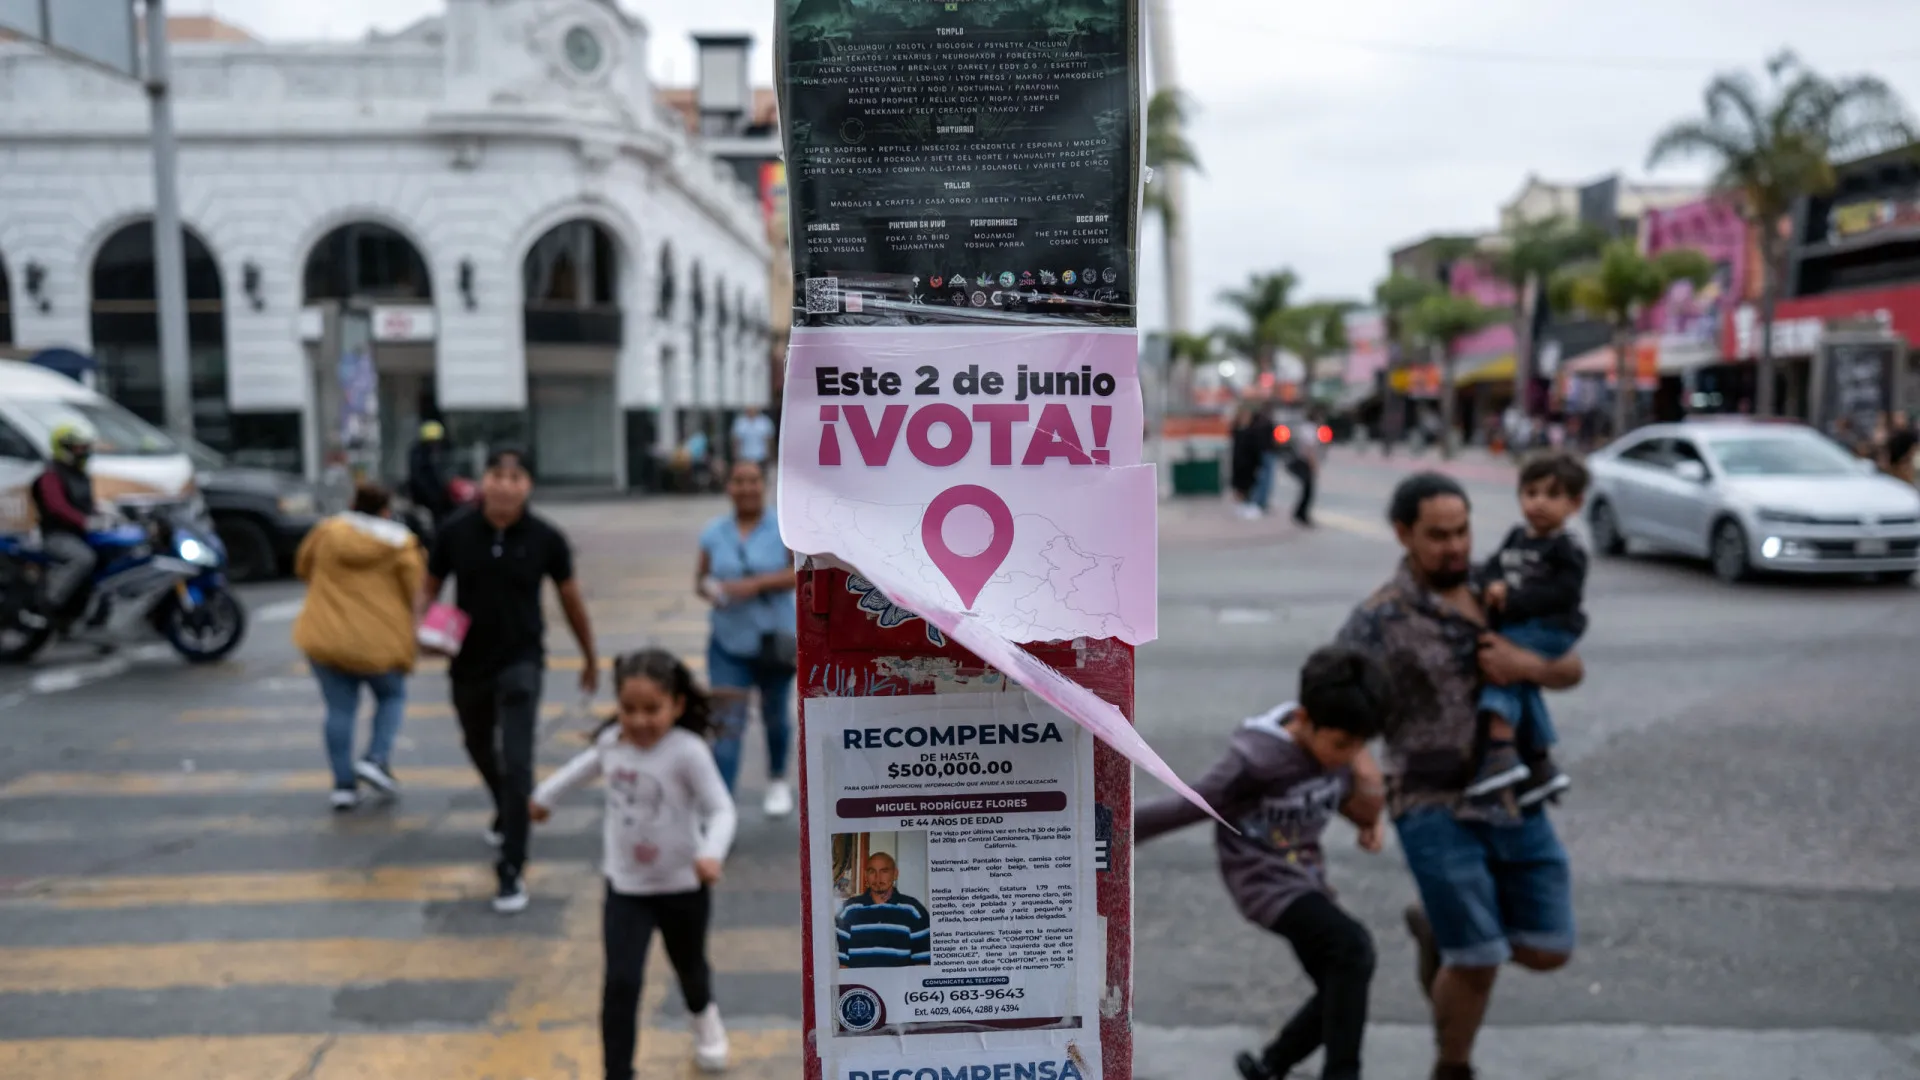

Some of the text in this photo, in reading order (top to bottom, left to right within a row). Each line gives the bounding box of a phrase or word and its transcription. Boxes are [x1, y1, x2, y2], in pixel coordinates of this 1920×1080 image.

[936, 27, 964, 36] TEMPLO
[936, 125, 974, 134] SANTUARIO
[944, 181, 971, 190] TALLER
[970, 218, 1018, 227] PERFORMANCE
[1076, 214, 1108, 222] DECO ART
[807, 223, 840, 231] VISUALES
[930, 219, 945, 227] VIVO
[1072, 228, 1108, 236] ELEMENT
[891, 243, 945, 251] TIJUANATHAN
[816, 365, 1116, 401] Este 2 de junio
[818, 403, 1112, 466] ¡VOTA!
[843, 722, 1063, 749] RECOMPENSA
[920, 752, 979, 762] DE HASTA
[888, 761, 1012, 779] $500,000.00
[876, 799, 1027, 812] MIGUEL RODRÍGUEZ FLORES
[916, 818, 928, 826] 44
[904, 988, 1024, 1004] (664) 683-9643
[915, 1008, 928, 1016] Ext.
[931, 1007, 950, 1015] 4029,
[952, 1006, 973, 1015] 4064,
[1001, 1004, 1019, 1012] 4394
